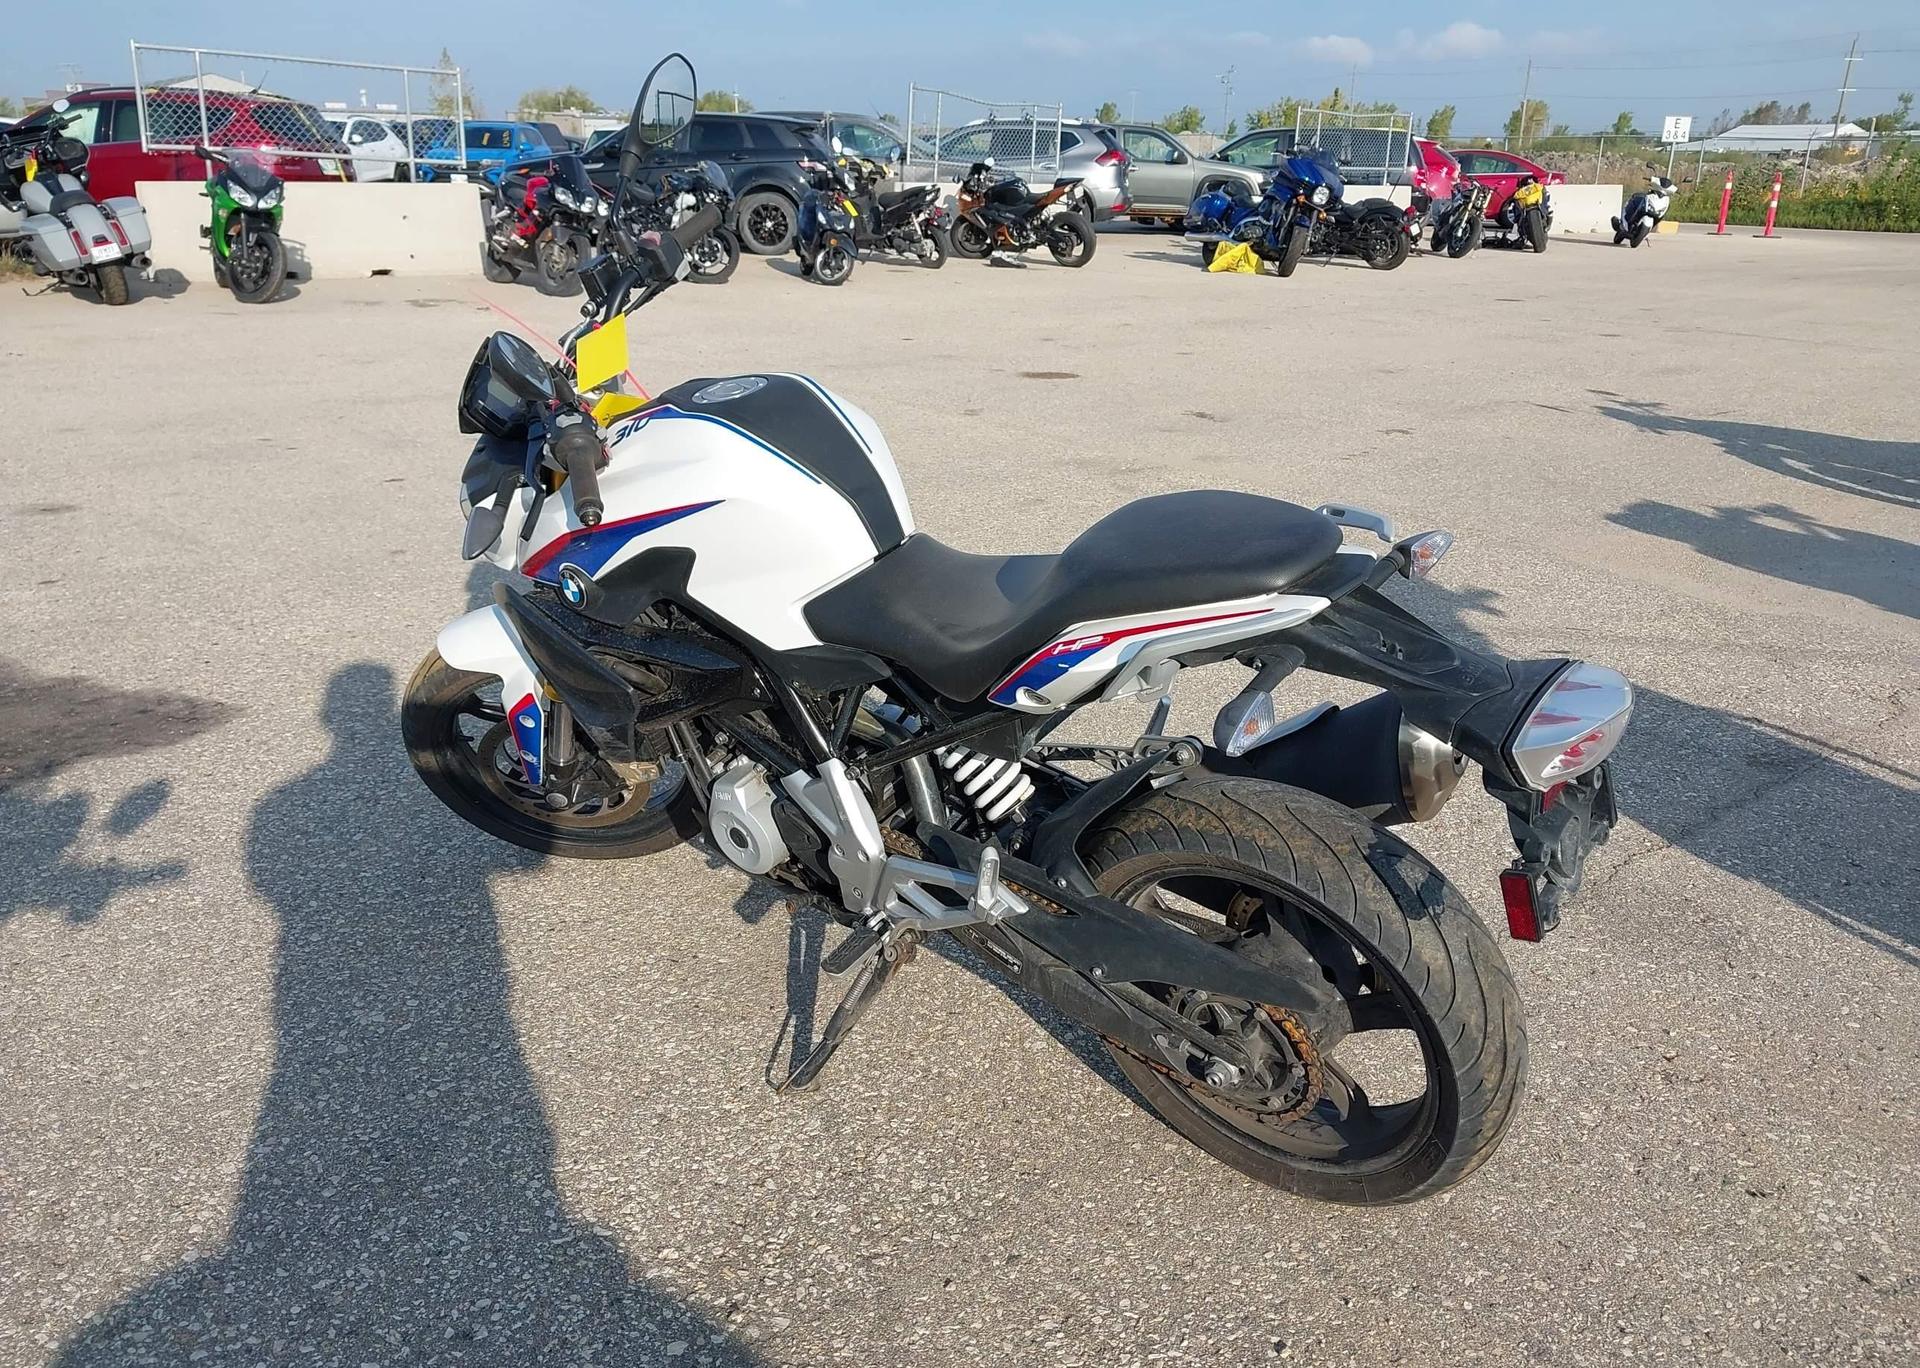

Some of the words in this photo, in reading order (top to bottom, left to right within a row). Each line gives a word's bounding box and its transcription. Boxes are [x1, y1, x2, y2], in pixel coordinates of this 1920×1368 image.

[1674, 118, 1682, 129] E
[1665, 130, 1671, 140] 3
[1672, 130, 1679, 140] &
[1681, 130, 1686, 140] 4
[610, 417, 650, 448] 310
[1052, 636, 1104, 655] HP
